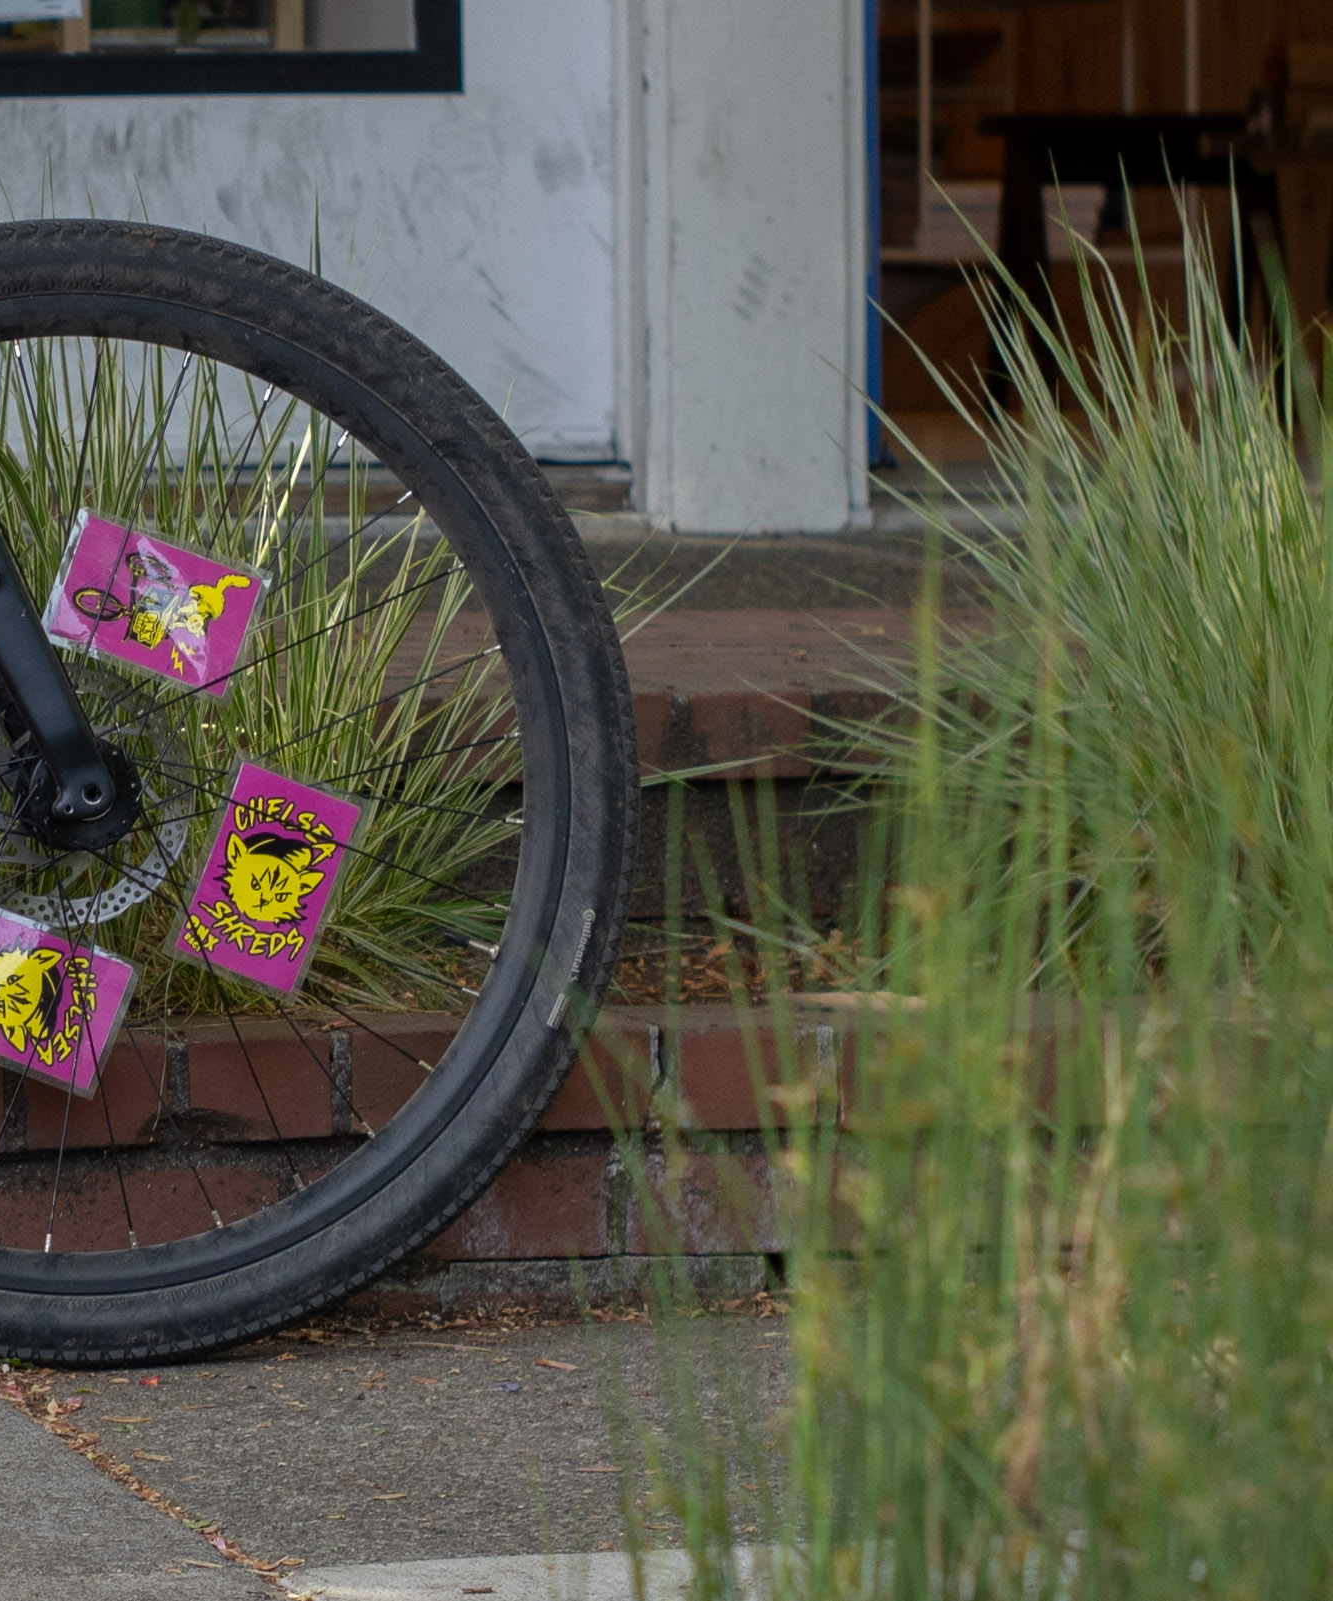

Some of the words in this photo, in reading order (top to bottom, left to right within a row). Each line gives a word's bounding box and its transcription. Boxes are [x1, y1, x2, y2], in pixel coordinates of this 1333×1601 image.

[234, 796, 337, 866] CHELSEA
[198, 901, 305, 961] SHREDS
[570, 908, 596, 977] Continental
[31, 957, 98, 1066] CHELSEA
